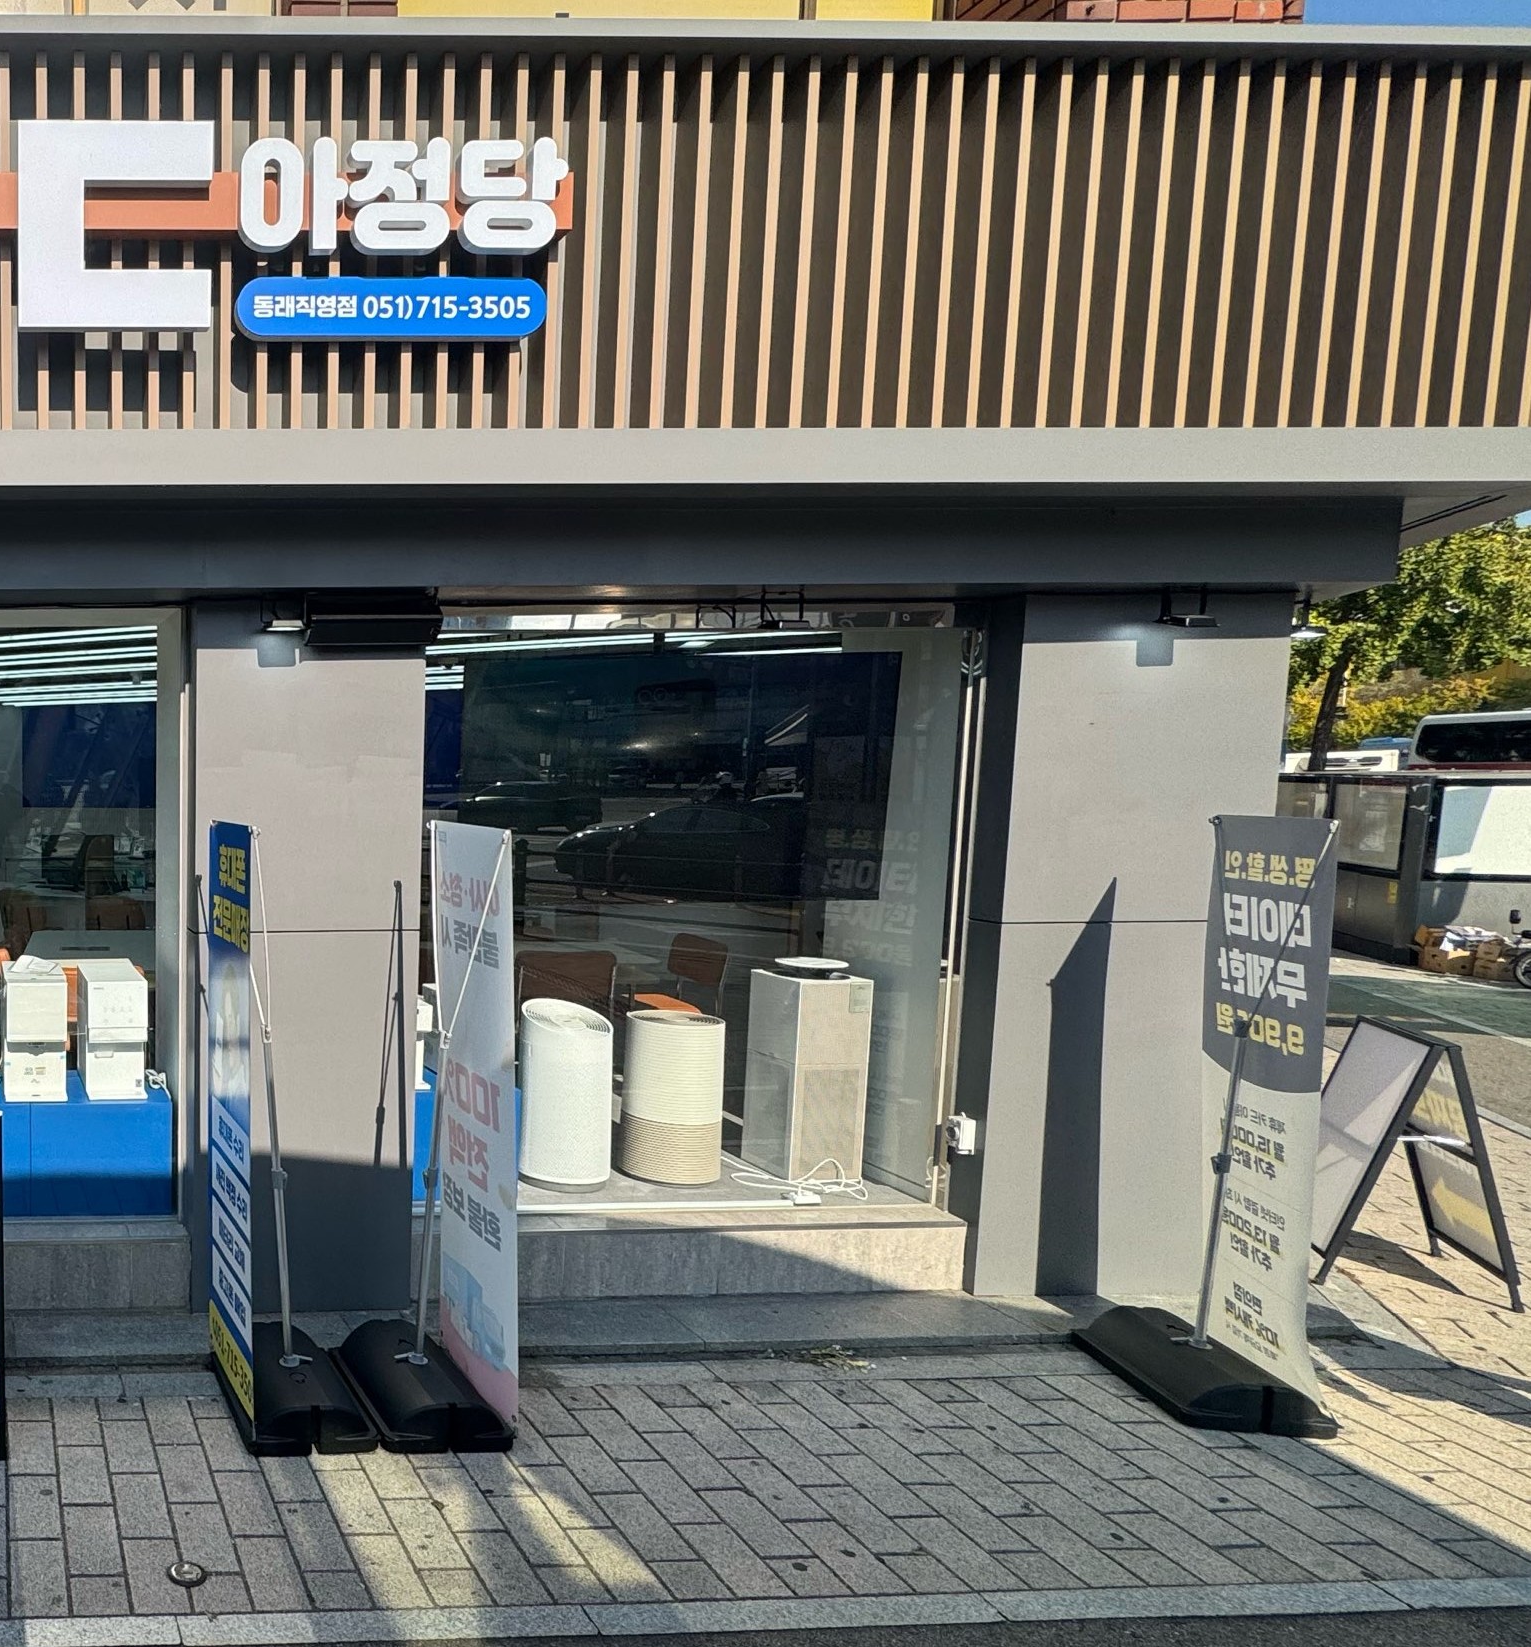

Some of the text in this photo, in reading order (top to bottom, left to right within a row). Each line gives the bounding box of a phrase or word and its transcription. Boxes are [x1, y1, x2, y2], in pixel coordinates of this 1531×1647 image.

[240, 136, 569, 252] 아정당
[253, 295, 531, 320] 동래직영점 051)715-3505
[218, 844, 246, 895] 휴대폰
[213, 895, 249, 954] 전문매장
[233, 1133, 245, 1164] 수리
[236, 1192, 247, 1224] 수리
